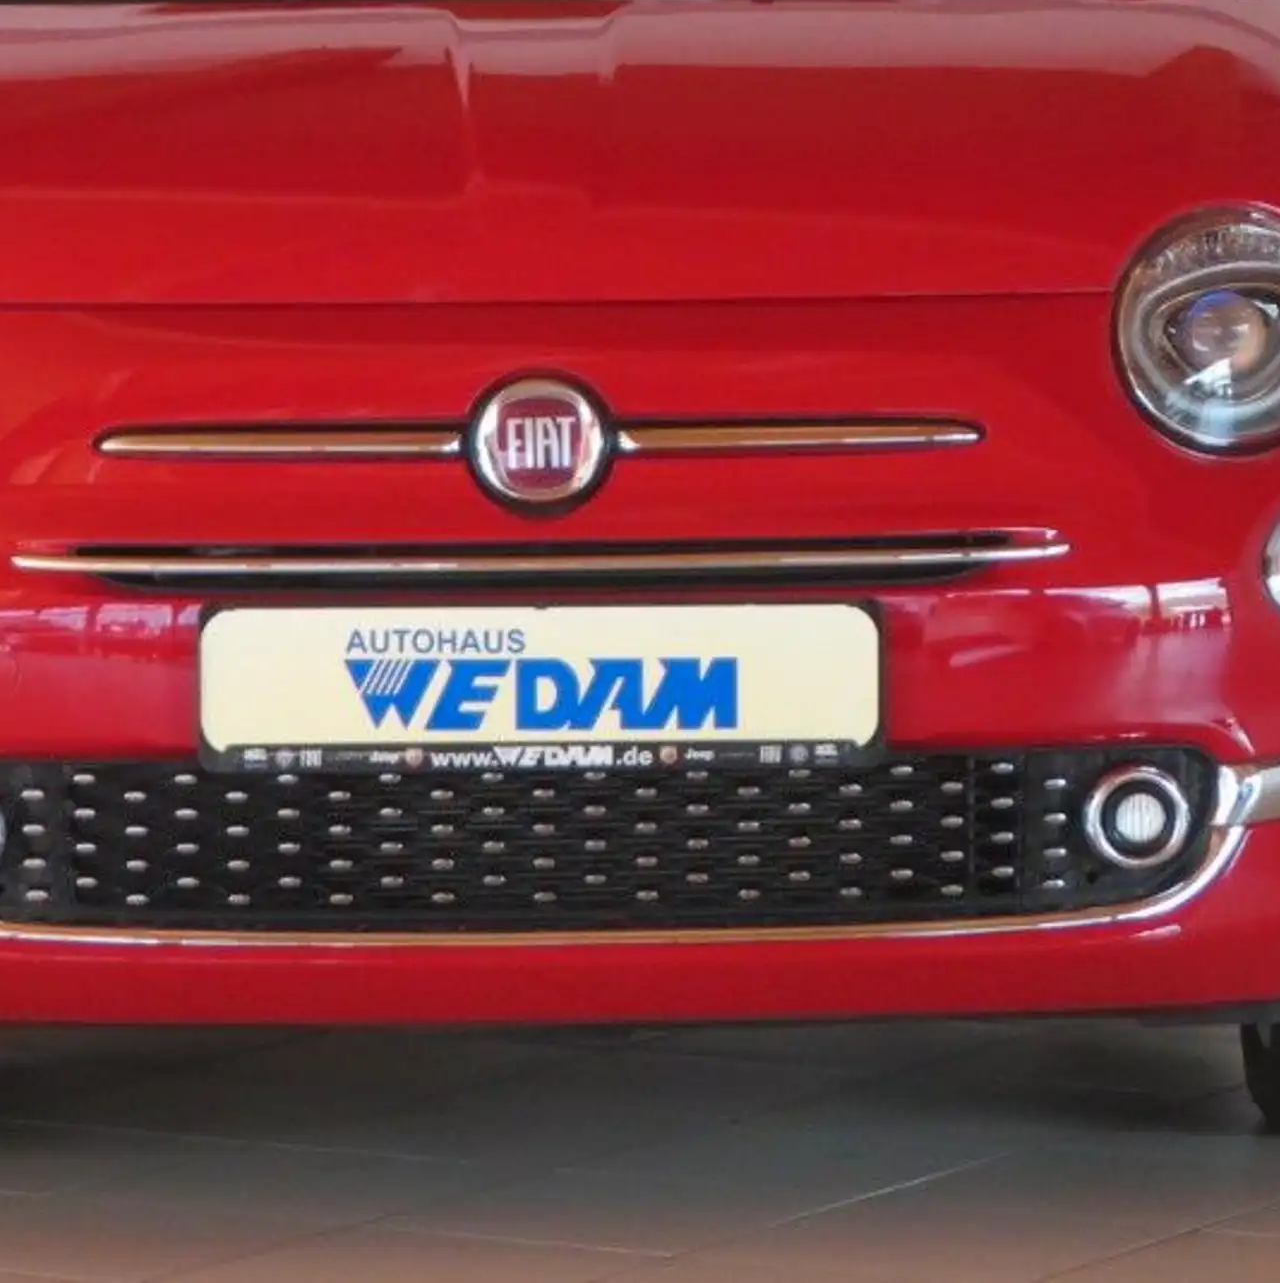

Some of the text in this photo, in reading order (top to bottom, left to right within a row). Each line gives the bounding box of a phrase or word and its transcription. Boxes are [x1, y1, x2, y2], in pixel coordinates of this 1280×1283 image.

[505, 416, 577, 469] FIAT
[346, 628, 526, 654] AUTOHAUS
[345, 657, 738, 731] WEDAM
[430, 745, 653, 767] www.WEDAM.de
